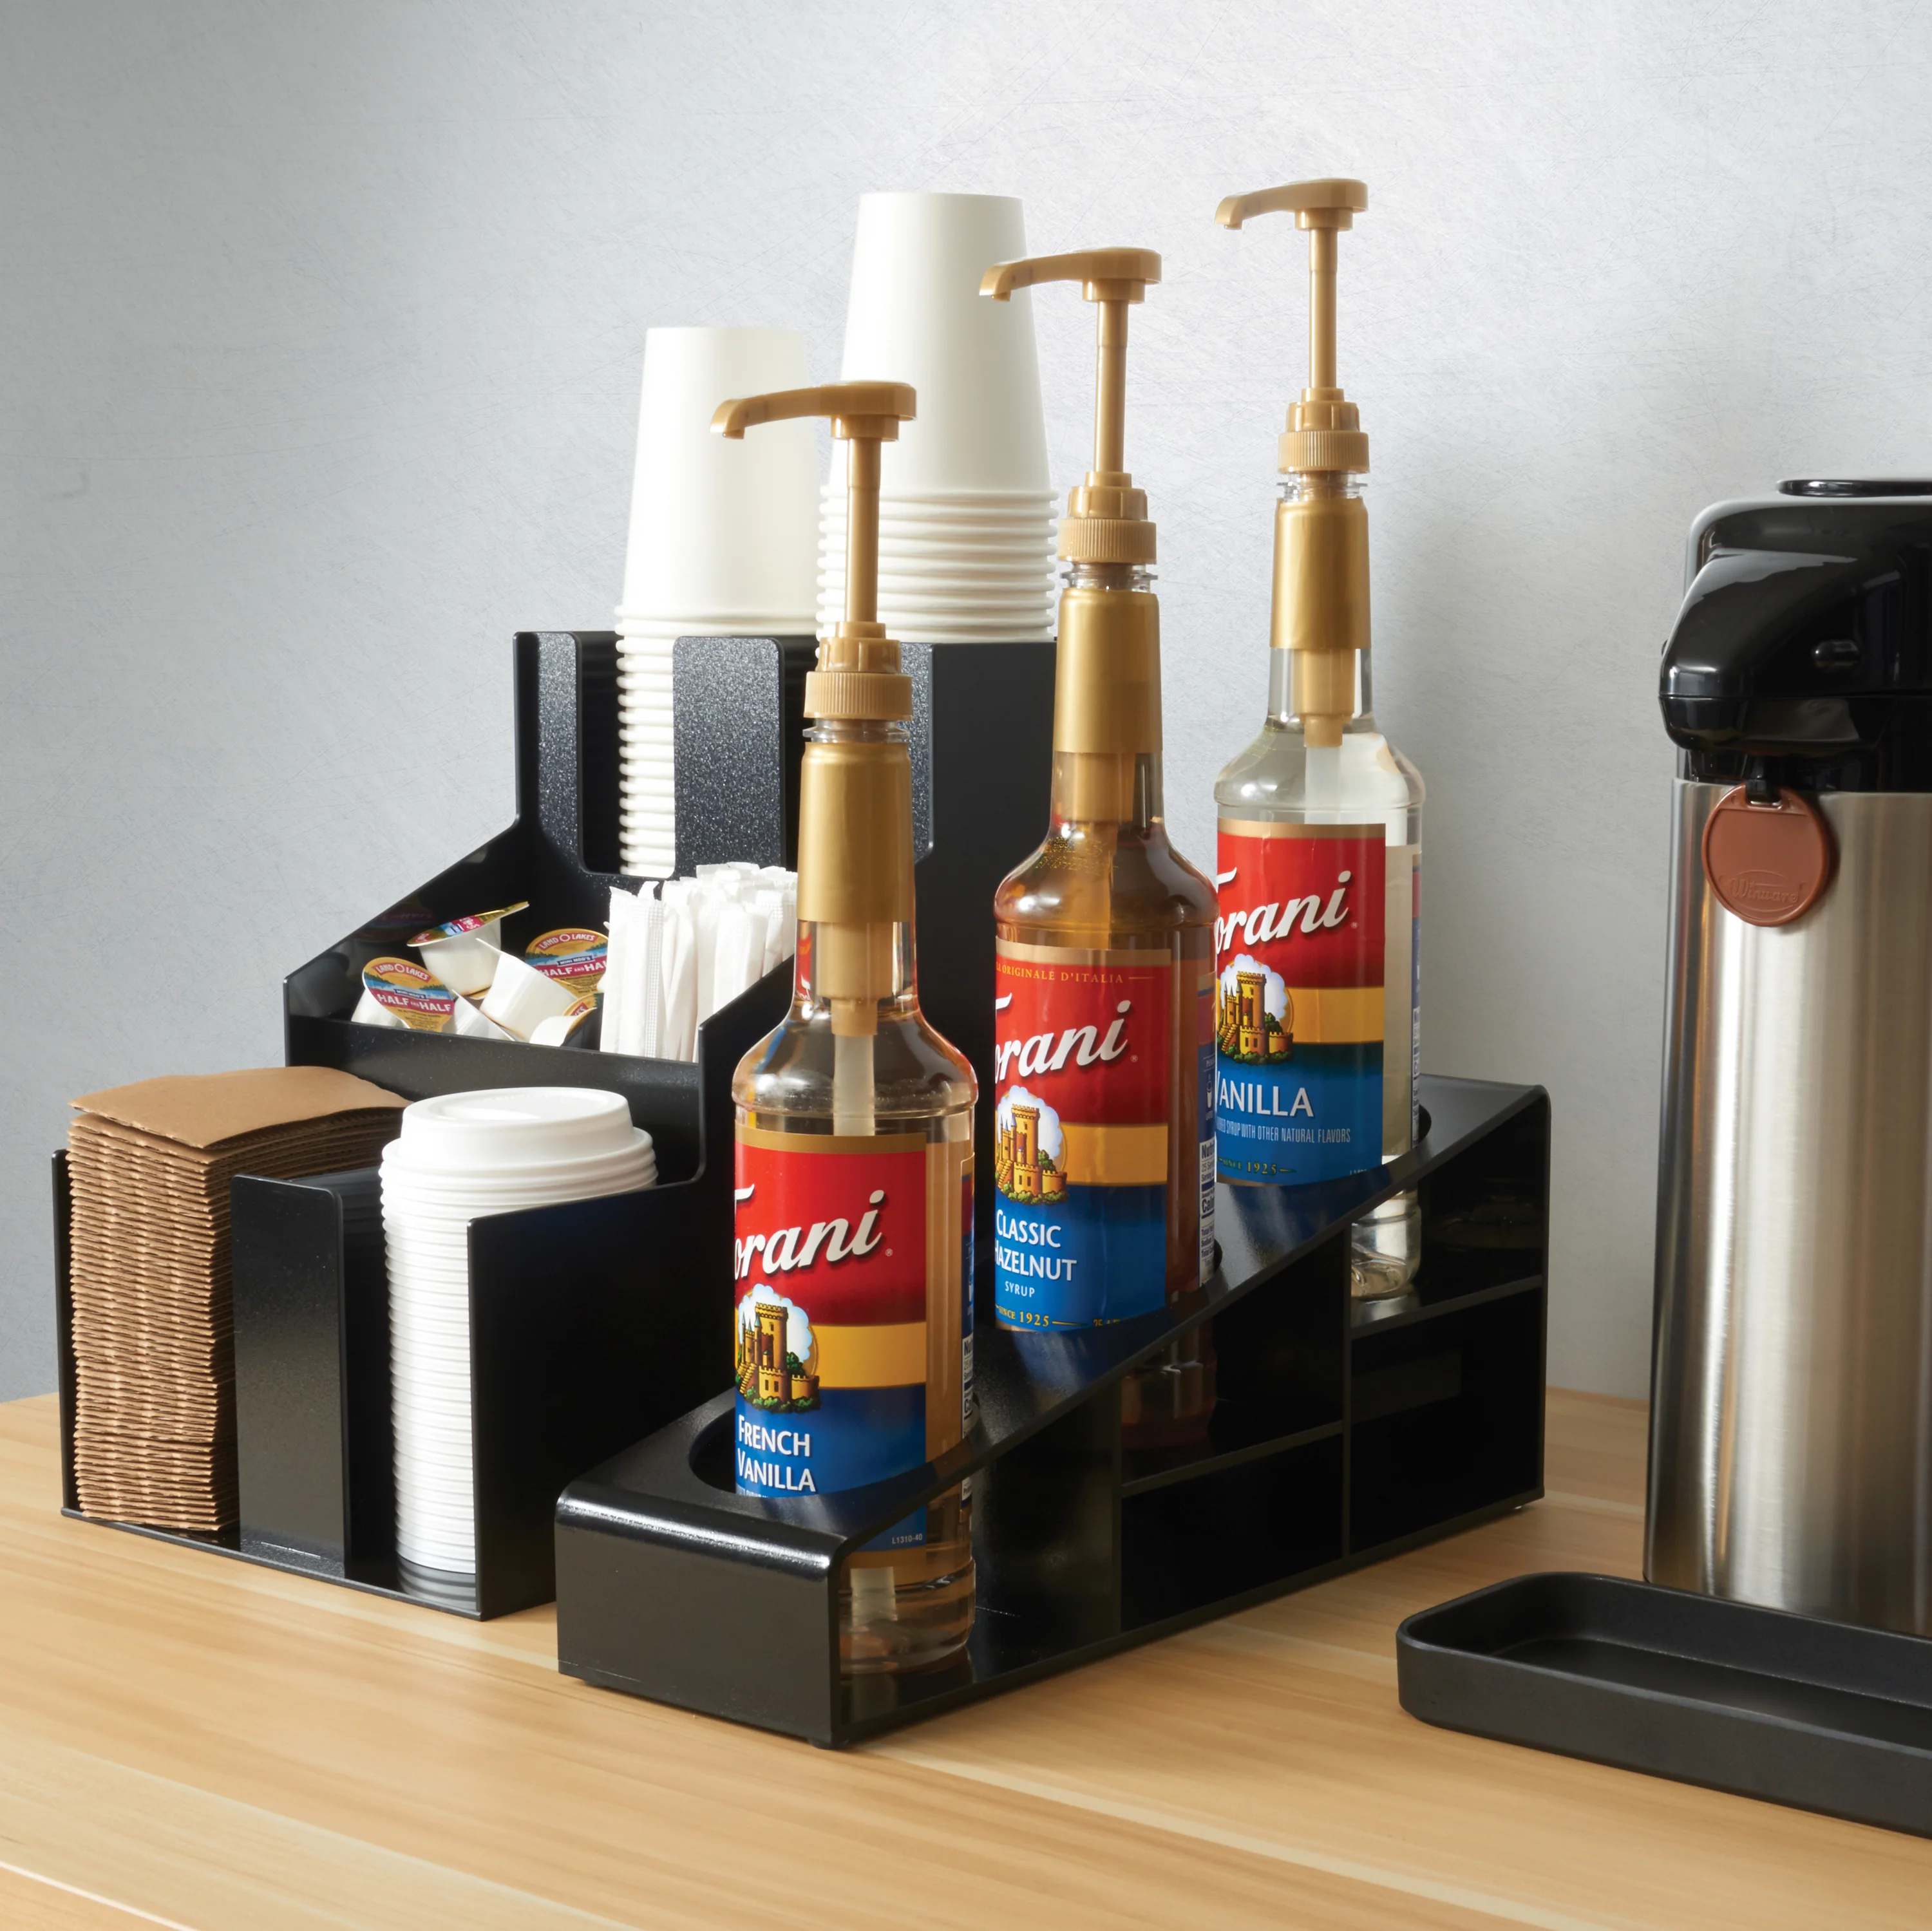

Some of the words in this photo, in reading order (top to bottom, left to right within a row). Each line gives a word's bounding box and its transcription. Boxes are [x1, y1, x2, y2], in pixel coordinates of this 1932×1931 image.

[1730, 878, 1799, 903] Winware
[539, 937, 559, 949] LAND
[559, 934, 571, 942] O
[375, 964, 394, 974] LAND
[394, 963, 405, 973] O
[406, 966, 429, 980] LAKES
[540, 966, 573, 977] HALF
[584, 960, 607, 972] HA
[1002, 964, 1055, 980] ORIGINALE
[1061, 972, 1123, 984] D'ITALIA
[376, 994, 409, 1005] HALF
[419, 1002, 451, 1012] HALF
[1241, 1123, 1255, 1139] WITH
[1258, 1126, 1279, 1142] OTHER
[1282, 1128, 1315, 1144] NATURAL
[1318, 1129, 1350, 1144] FLAVORS
[1247, 1162, 1277, 1175] 1925
[996, 1209, 1062, 1248] CLASSIC
[994, 1238, 1077, 1281] HAZELNUT
[1005, 1281, 1035, 1297] SYRUP
[998, 1306, 1016, 1320] SINCE
[1019, 1311, 1049, 1327] 1925
[739, 1414, 811, 1458] FRENCH
[737, 1448, 816, 1493] VANILLA
